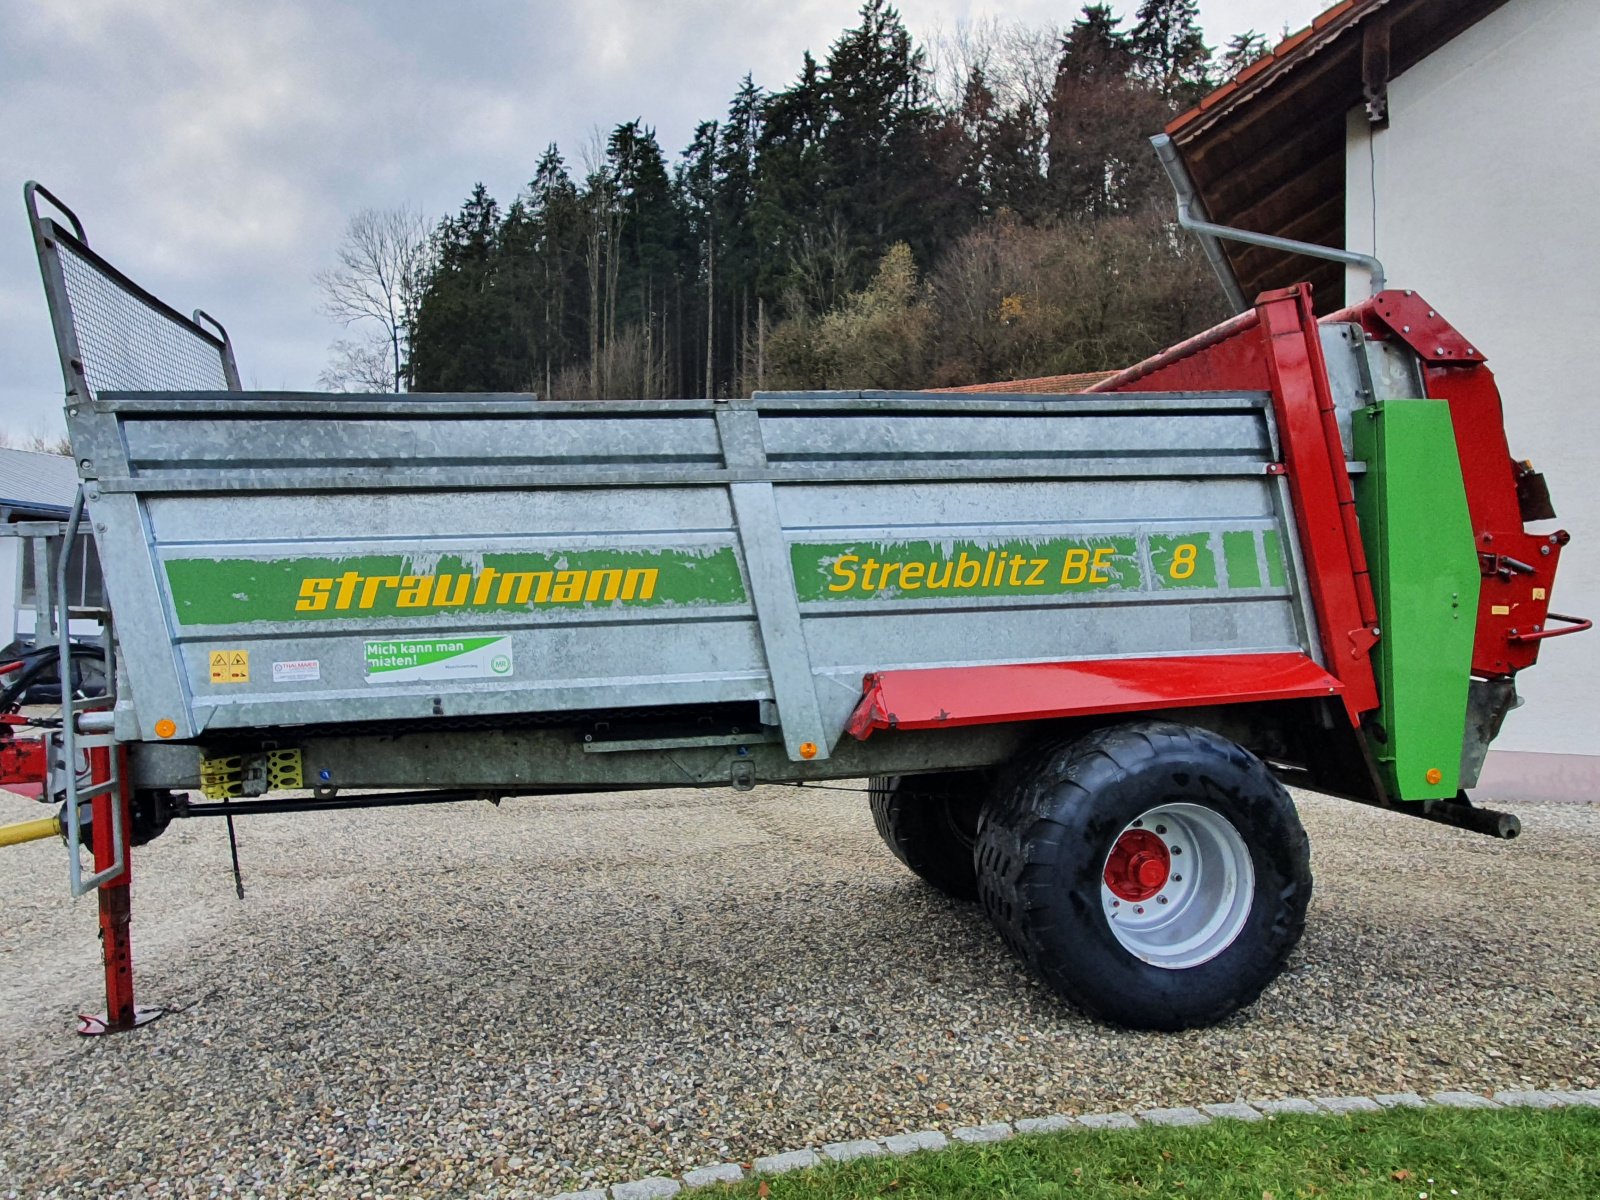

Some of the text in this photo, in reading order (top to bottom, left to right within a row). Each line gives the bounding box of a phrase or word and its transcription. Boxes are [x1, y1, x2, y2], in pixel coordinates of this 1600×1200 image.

[828, 544, 1198, 592] Streublitz BE 8
[295, 567, 659, 611] strautmann
[367, 642, 464, 655] Mich kann man
[367, 654, 418, 667] mieten!
